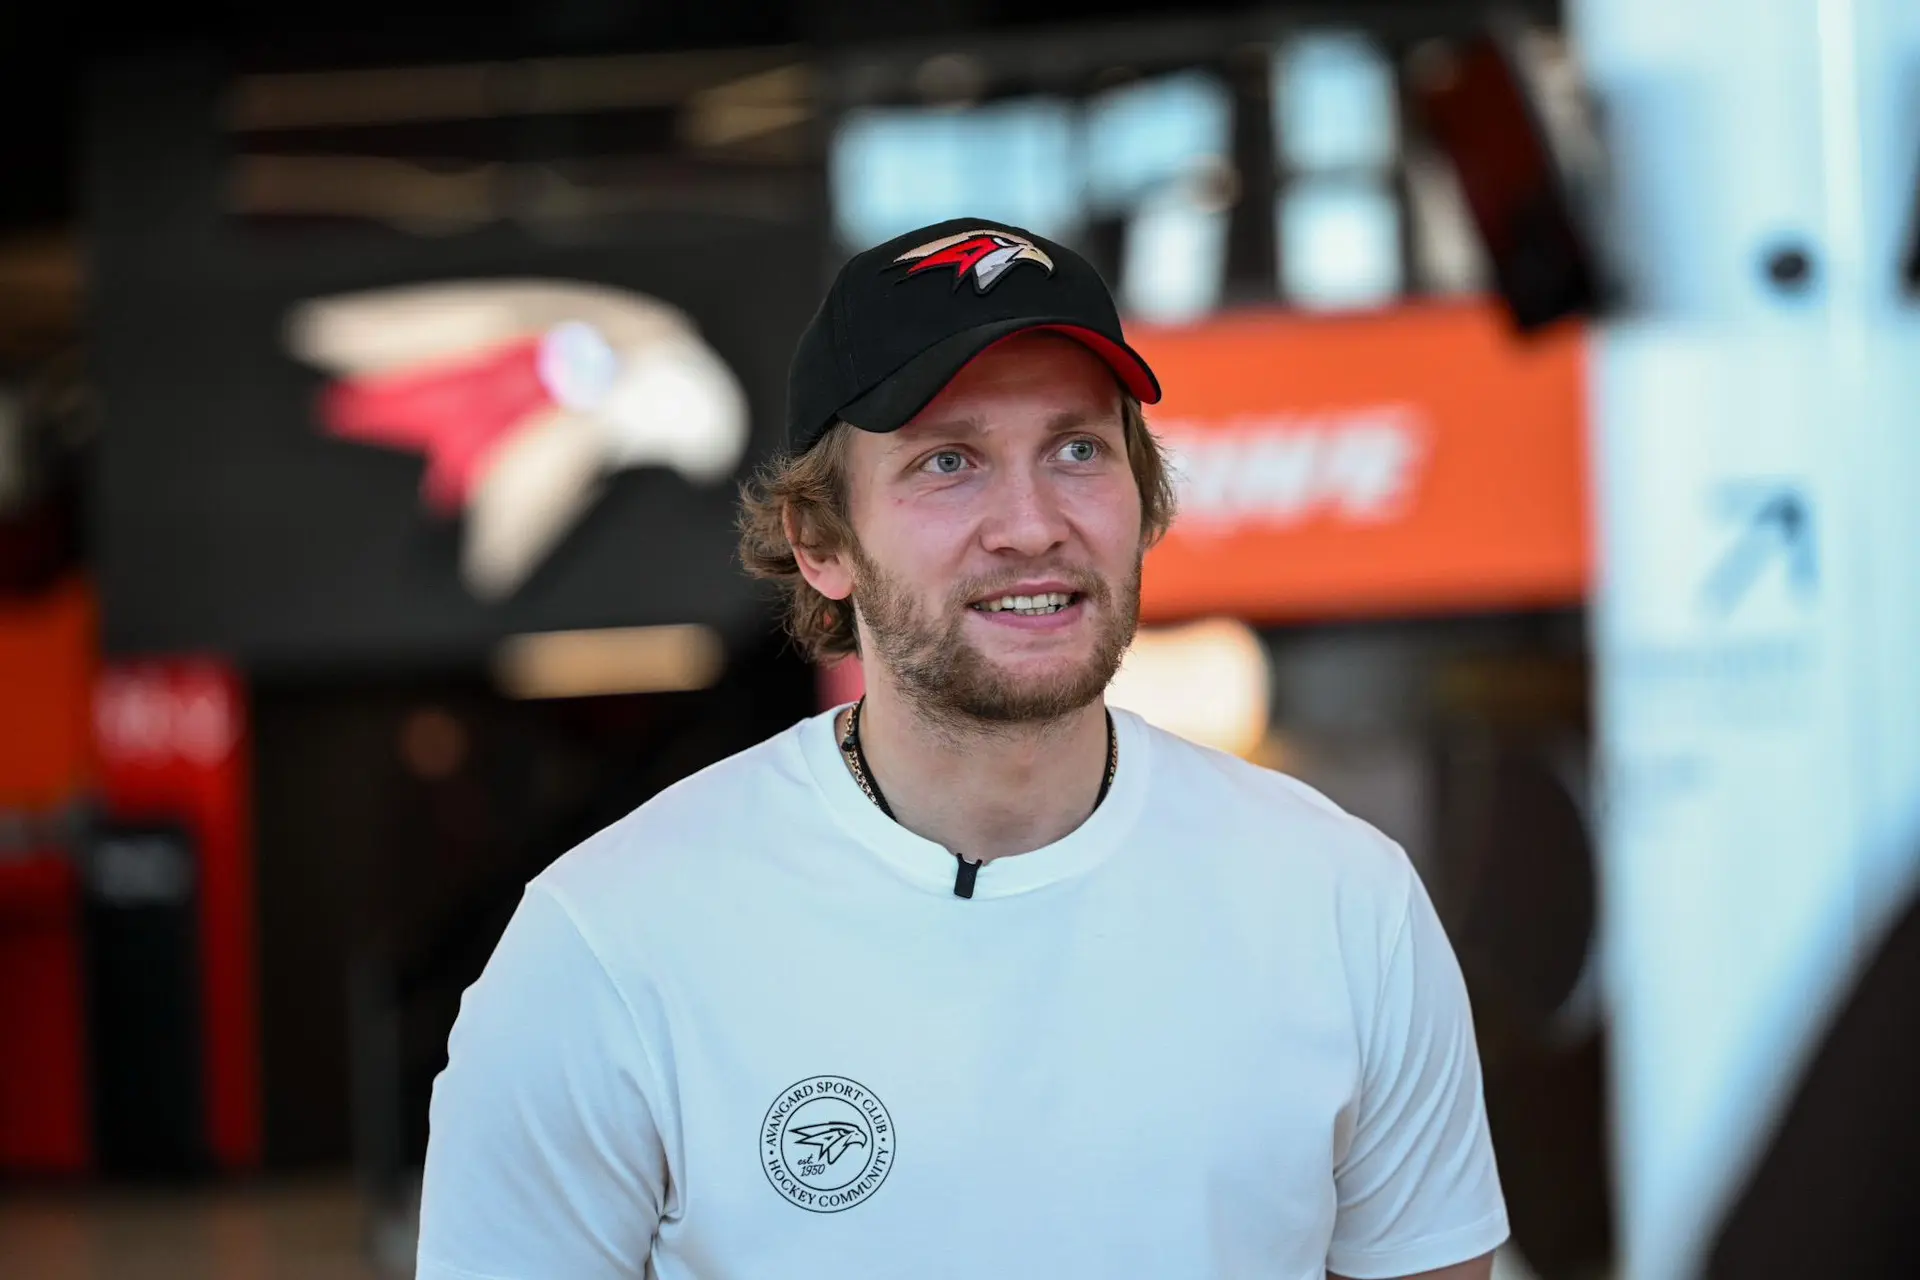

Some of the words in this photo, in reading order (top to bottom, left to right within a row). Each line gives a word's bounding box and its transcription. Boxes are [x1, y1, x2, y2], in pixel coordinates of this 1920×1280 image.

[766, 1084, 814, 1146] AVANGARD
[816, 1081, 864, 1101] SPORT
[862, 1099, 887, 1134] CLUB
[768, 1159, 817, 1205] HOCKEY
[818, 1146, 889, 1207] COMMUNITY
[800, 1163, 826, 1177] 1950
